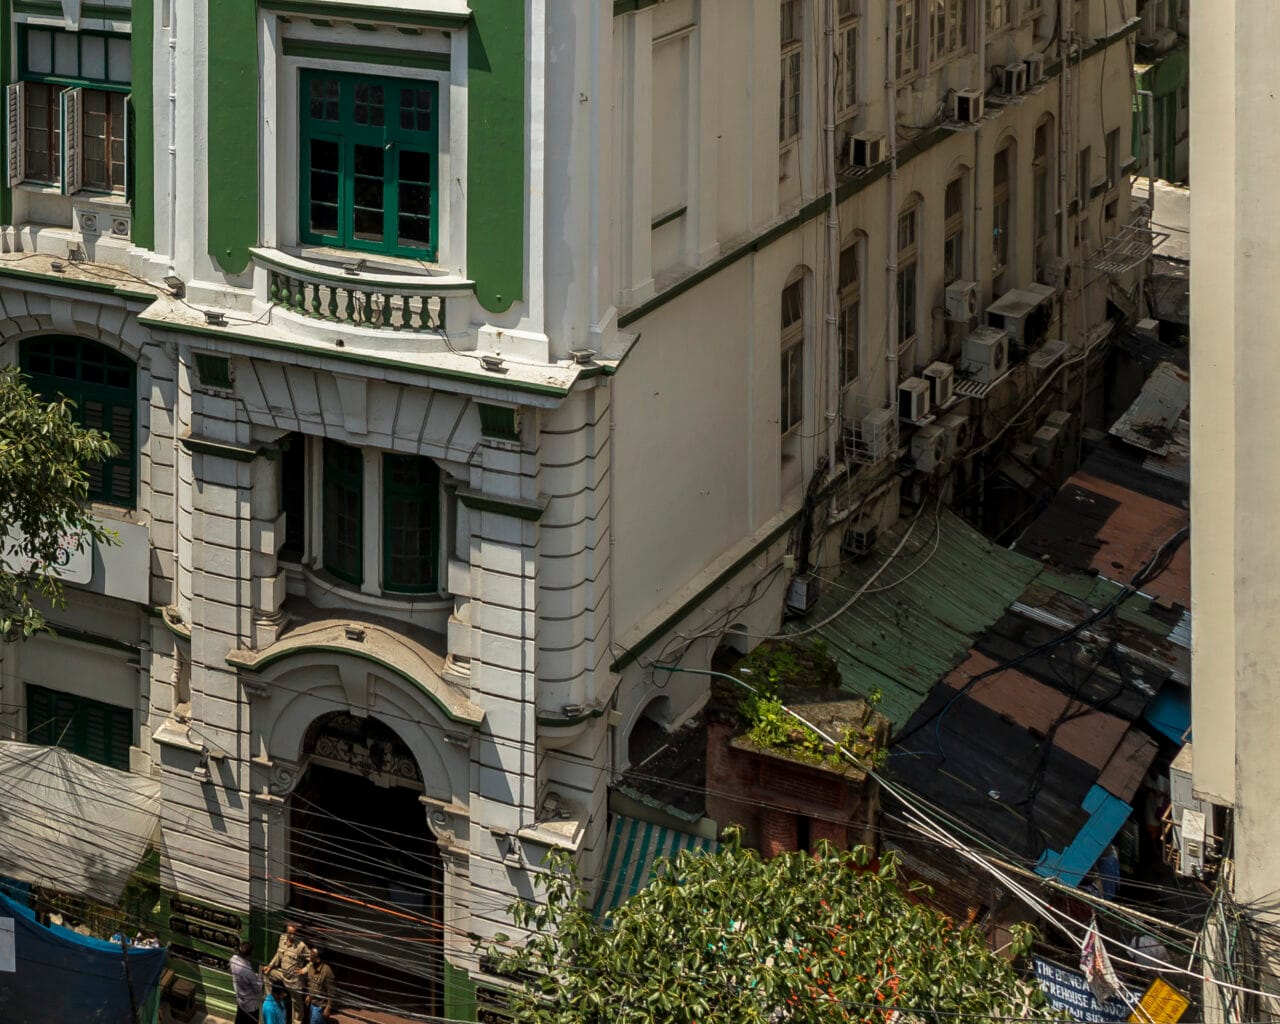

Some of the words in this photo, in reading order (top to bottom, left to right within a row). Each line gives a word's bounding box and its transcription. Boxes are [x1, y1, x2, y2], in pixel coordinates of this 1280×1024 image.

[1035, 960, 1055, 979] THE
[1055, 968, 1091, 993] BENGA
[1051, 1000, 1083, 1019] NETAJI
